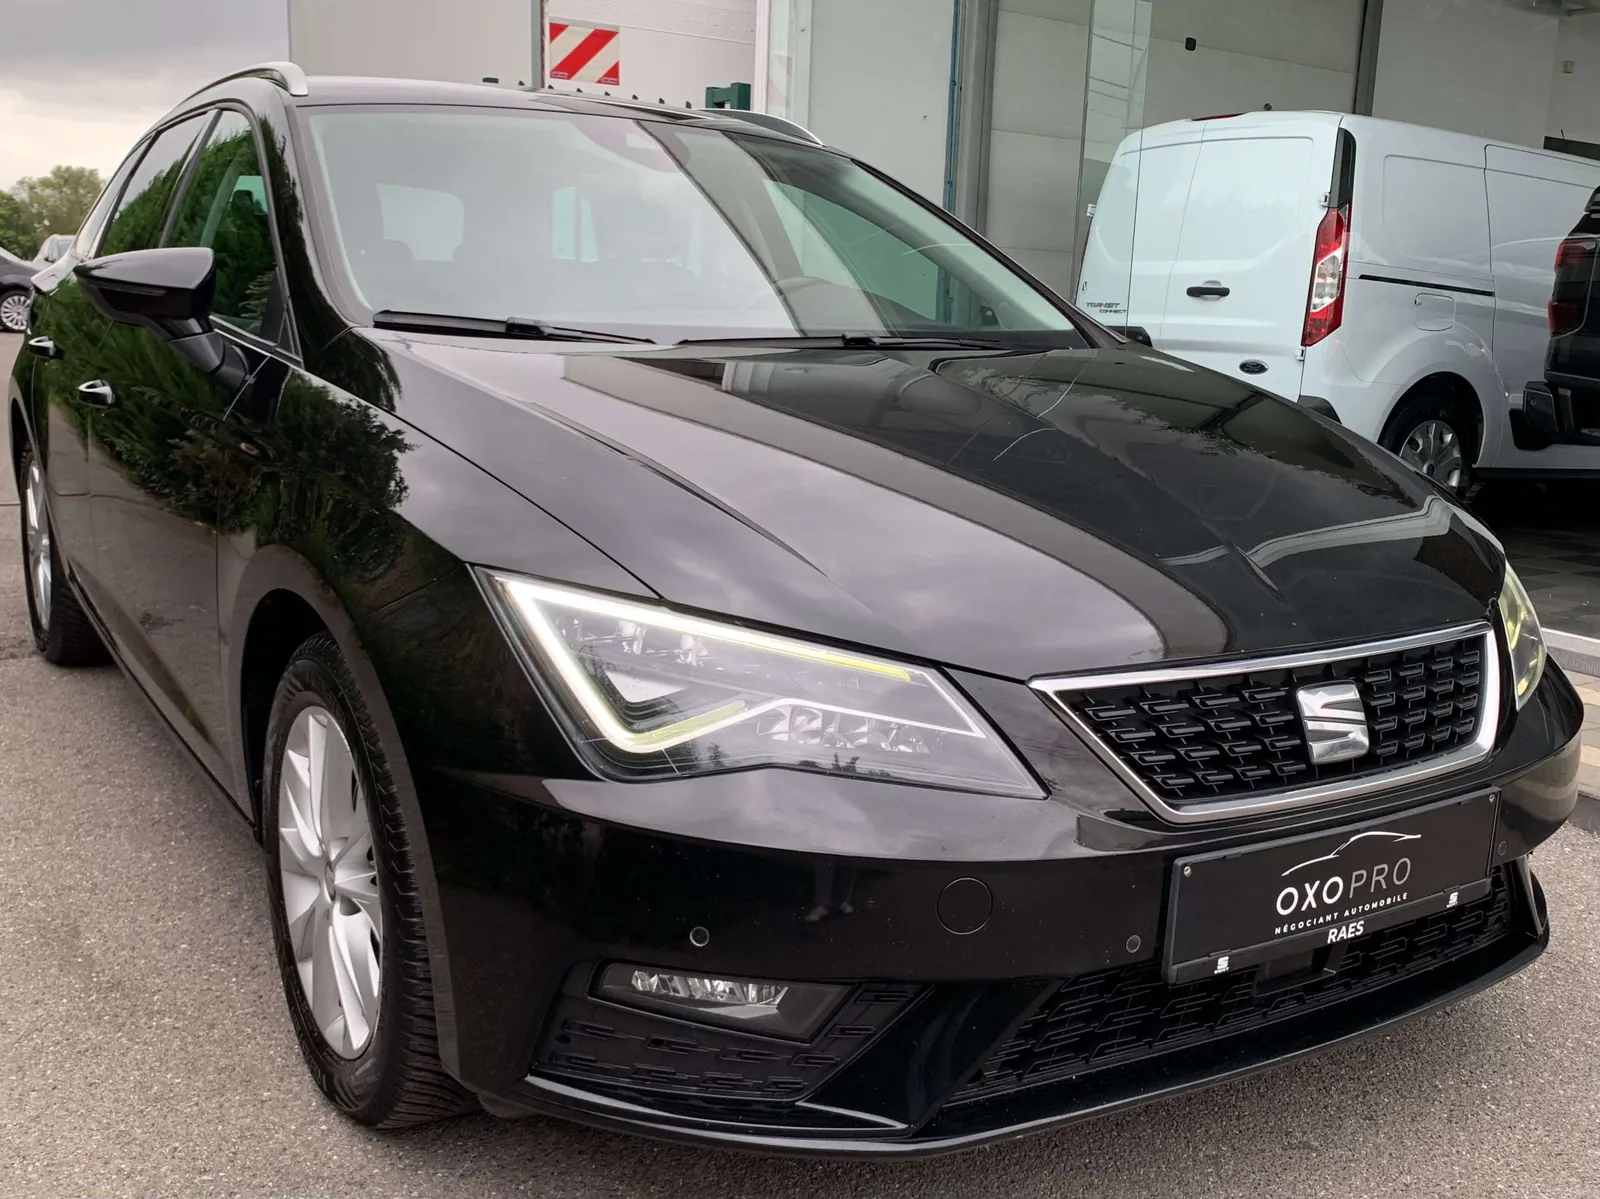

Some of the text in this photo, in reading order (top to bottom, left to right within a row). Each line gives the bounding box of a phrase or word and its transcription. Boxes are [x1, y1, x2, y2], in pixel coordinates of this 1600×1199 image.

[1276, 857, 1411, 916] OXOPRO
[1274, 892, 1408, 935] NÉGOCIANT AUTOMOBILE
[1327, 920, 1365, 944] RAES
